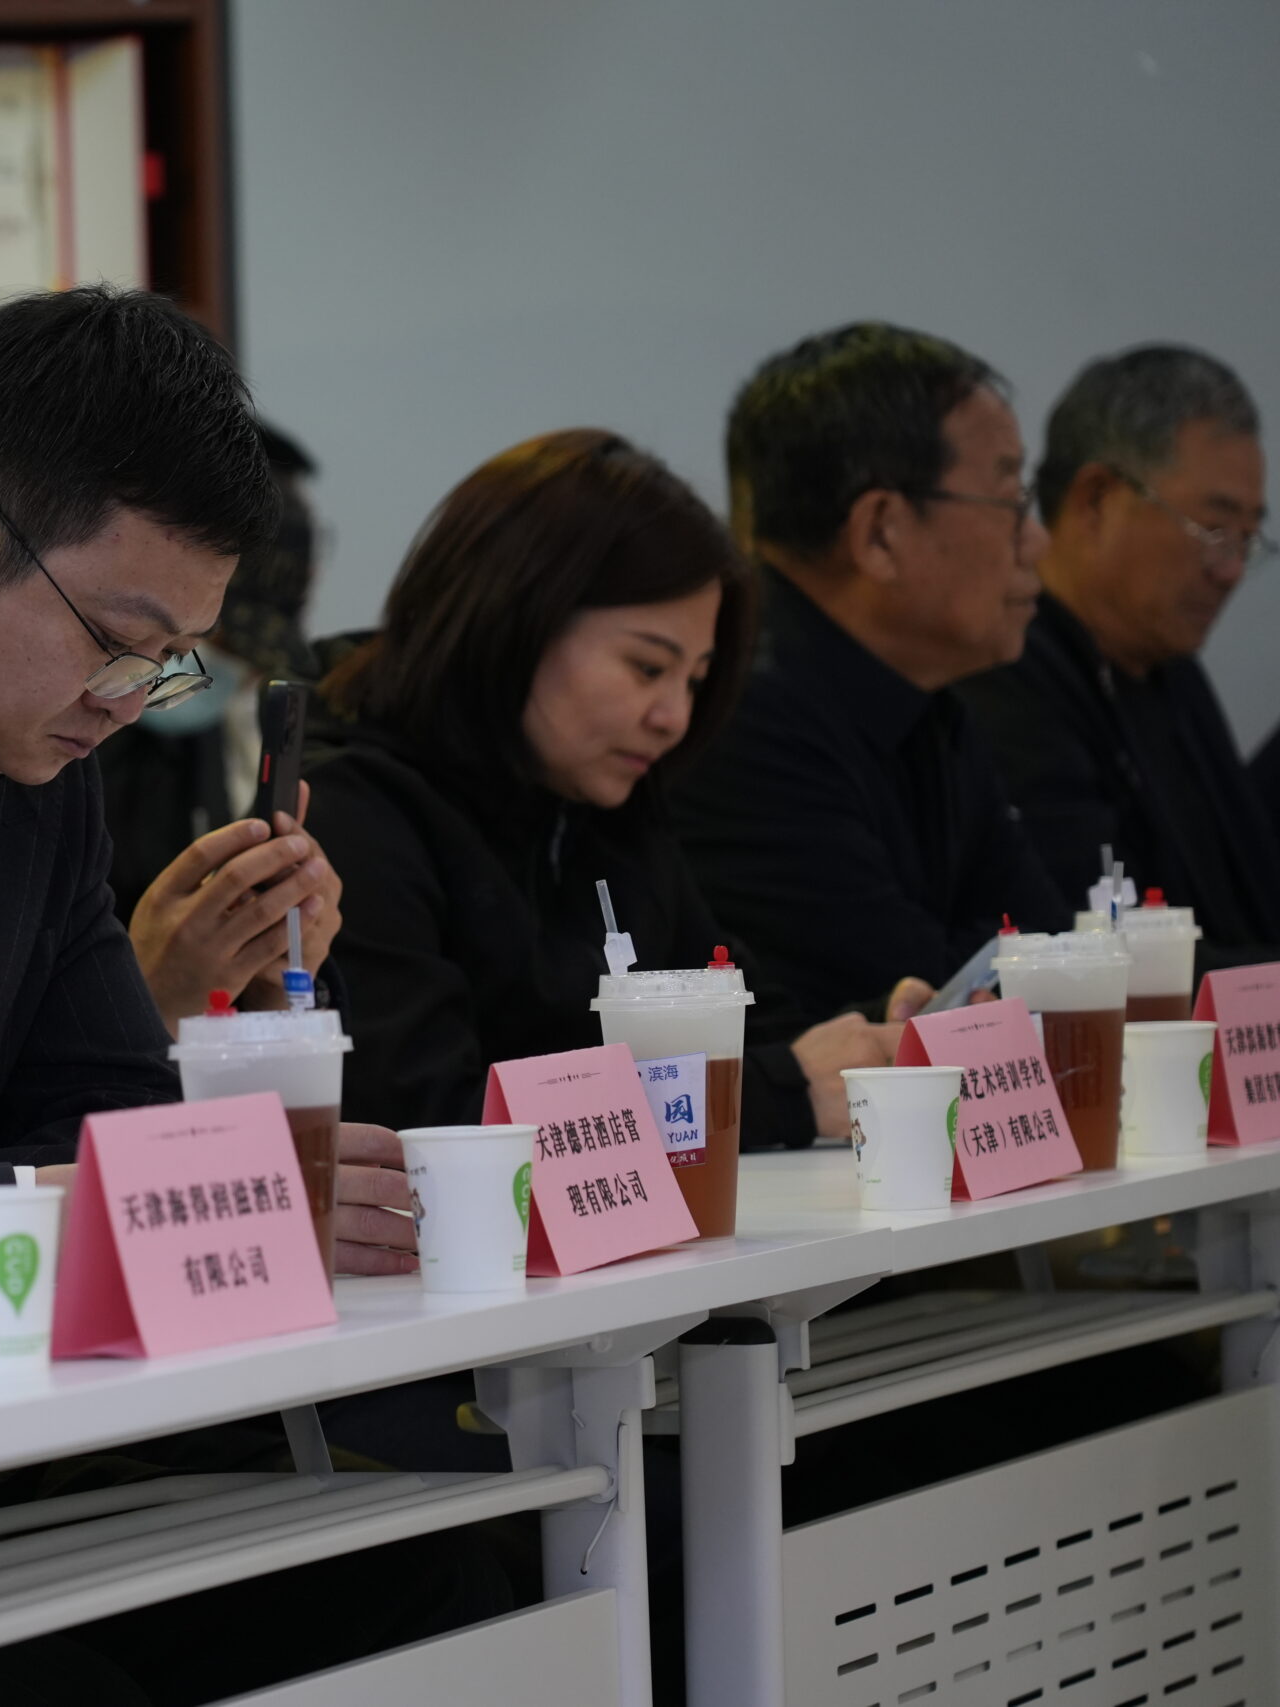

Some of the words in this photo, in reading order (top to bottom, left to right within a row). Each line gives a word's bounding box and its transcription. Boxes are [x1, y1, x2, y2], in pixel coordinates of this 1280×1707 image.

[648, 1065, 679, 1082] 滨海
[536, 1107, 641, 1161] 天津德君酒店管
[667, 1129, 698, 1144] YUAN
[962, 1107, 1060, 1157] （天津）有限公司
[566, 1169, 648, 1217] 理有限公司
[183, 1244, 269, 1296] 有限公司
